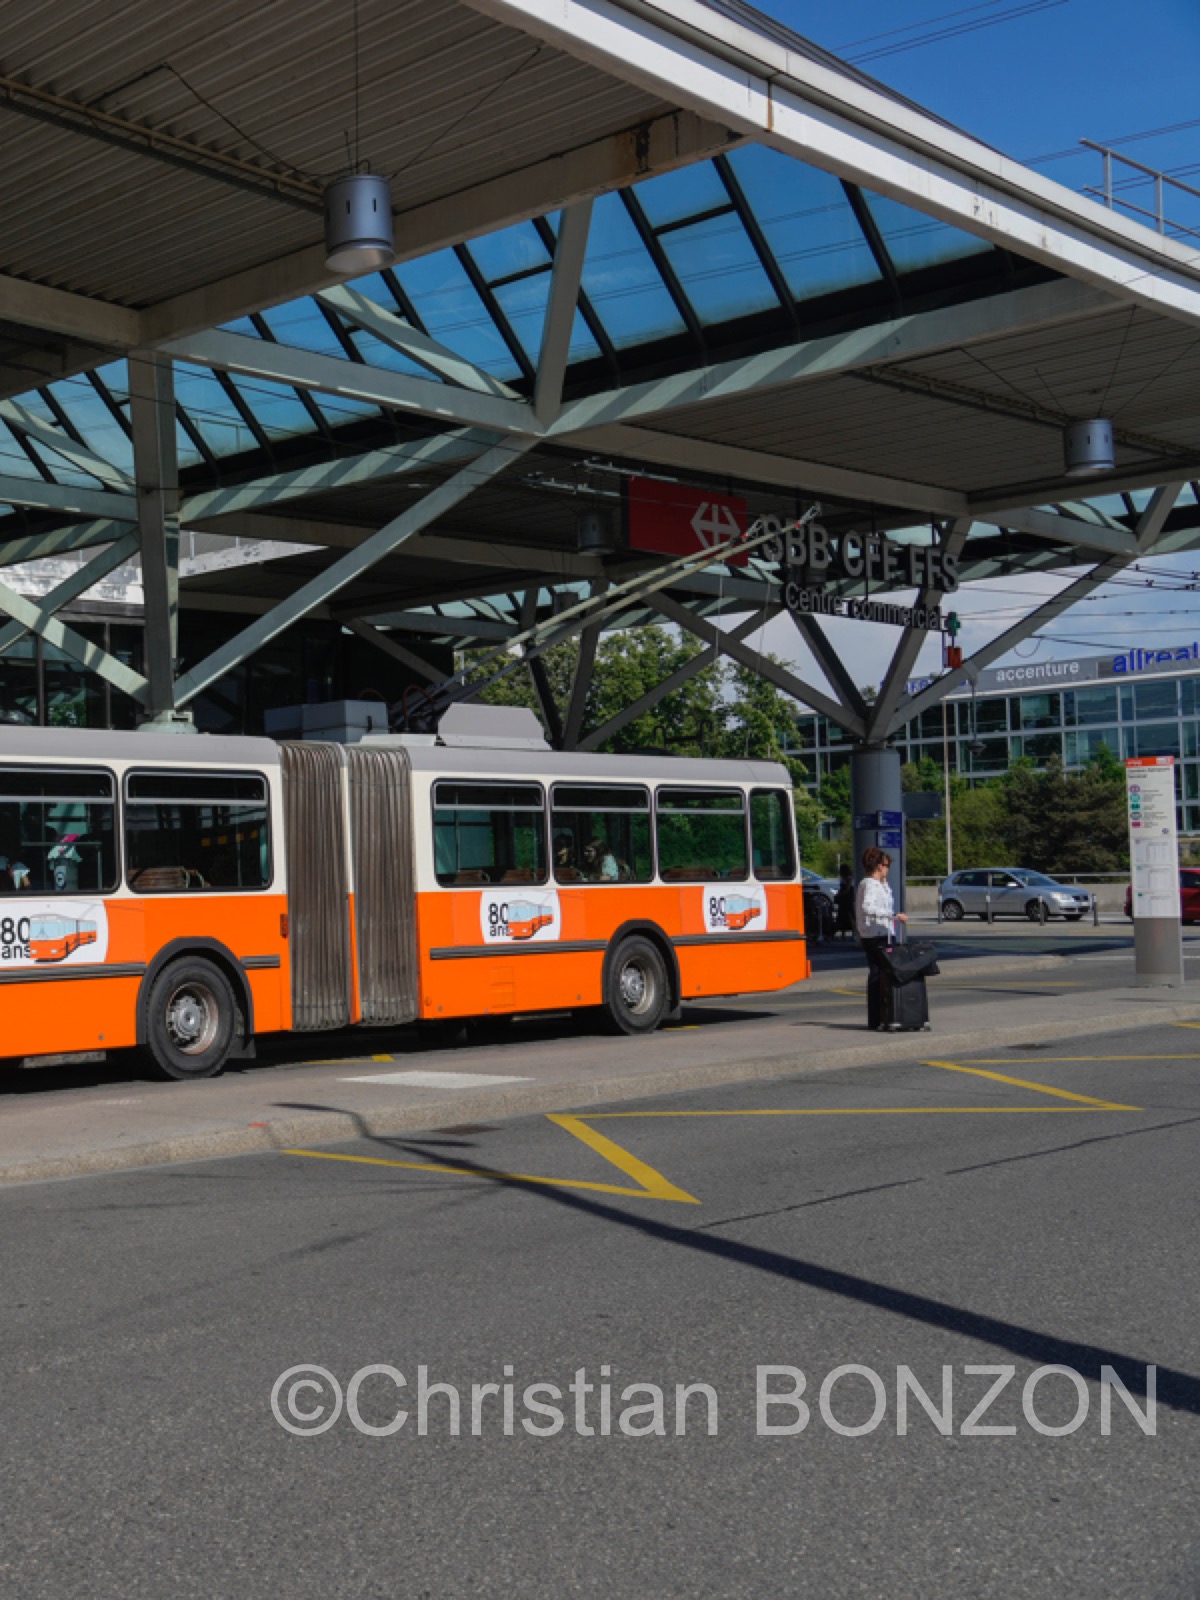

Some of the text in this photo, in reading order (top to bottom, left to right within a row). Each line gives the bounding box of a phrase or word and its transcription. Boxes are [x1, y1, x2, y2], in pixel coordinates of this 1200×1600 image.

[785, 581, 942, 630] Centre commercial
[995, 658, 1081, 682] accenture
[1113, 642, 1199, 673] allreal
[488, 902, 509, 924] 80
[0, 917, 31, 945] 80
